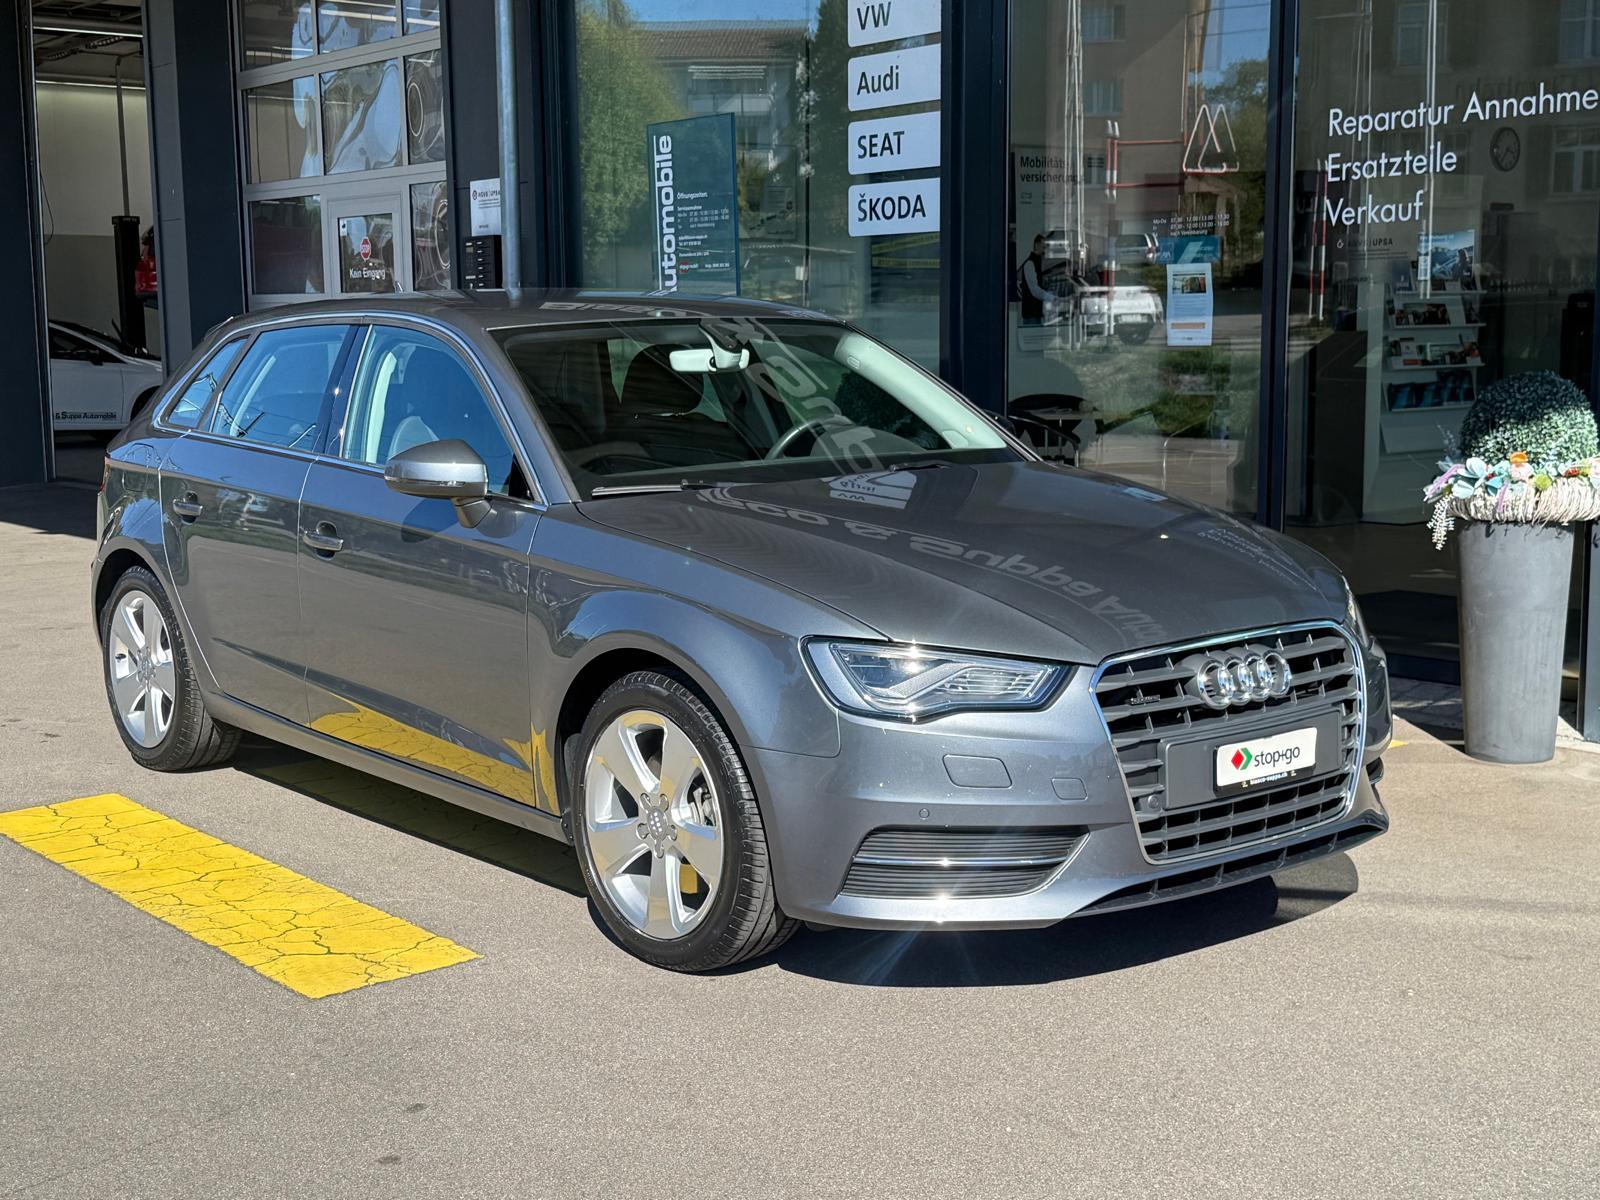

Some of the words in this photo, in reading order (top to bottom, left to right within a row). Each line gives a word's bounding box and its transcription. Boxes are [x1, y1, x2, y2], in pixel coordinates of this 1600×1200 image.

[856, 2, 892, 31] VW
[856, 65, 899, 96] Audi
[1328, 101, 1455, 142] Reparatur
[1462, 82, 1600, 122] Annahme
[857, 131, 905, 159] SEAT
[1327, 141, 1457, 182] Ersatzteile
[857, 193, 926, 222] ŠKODA
[1325, 189, 1424, 227] Verkauf
[1254, 746, 1301, 768] stop+go
